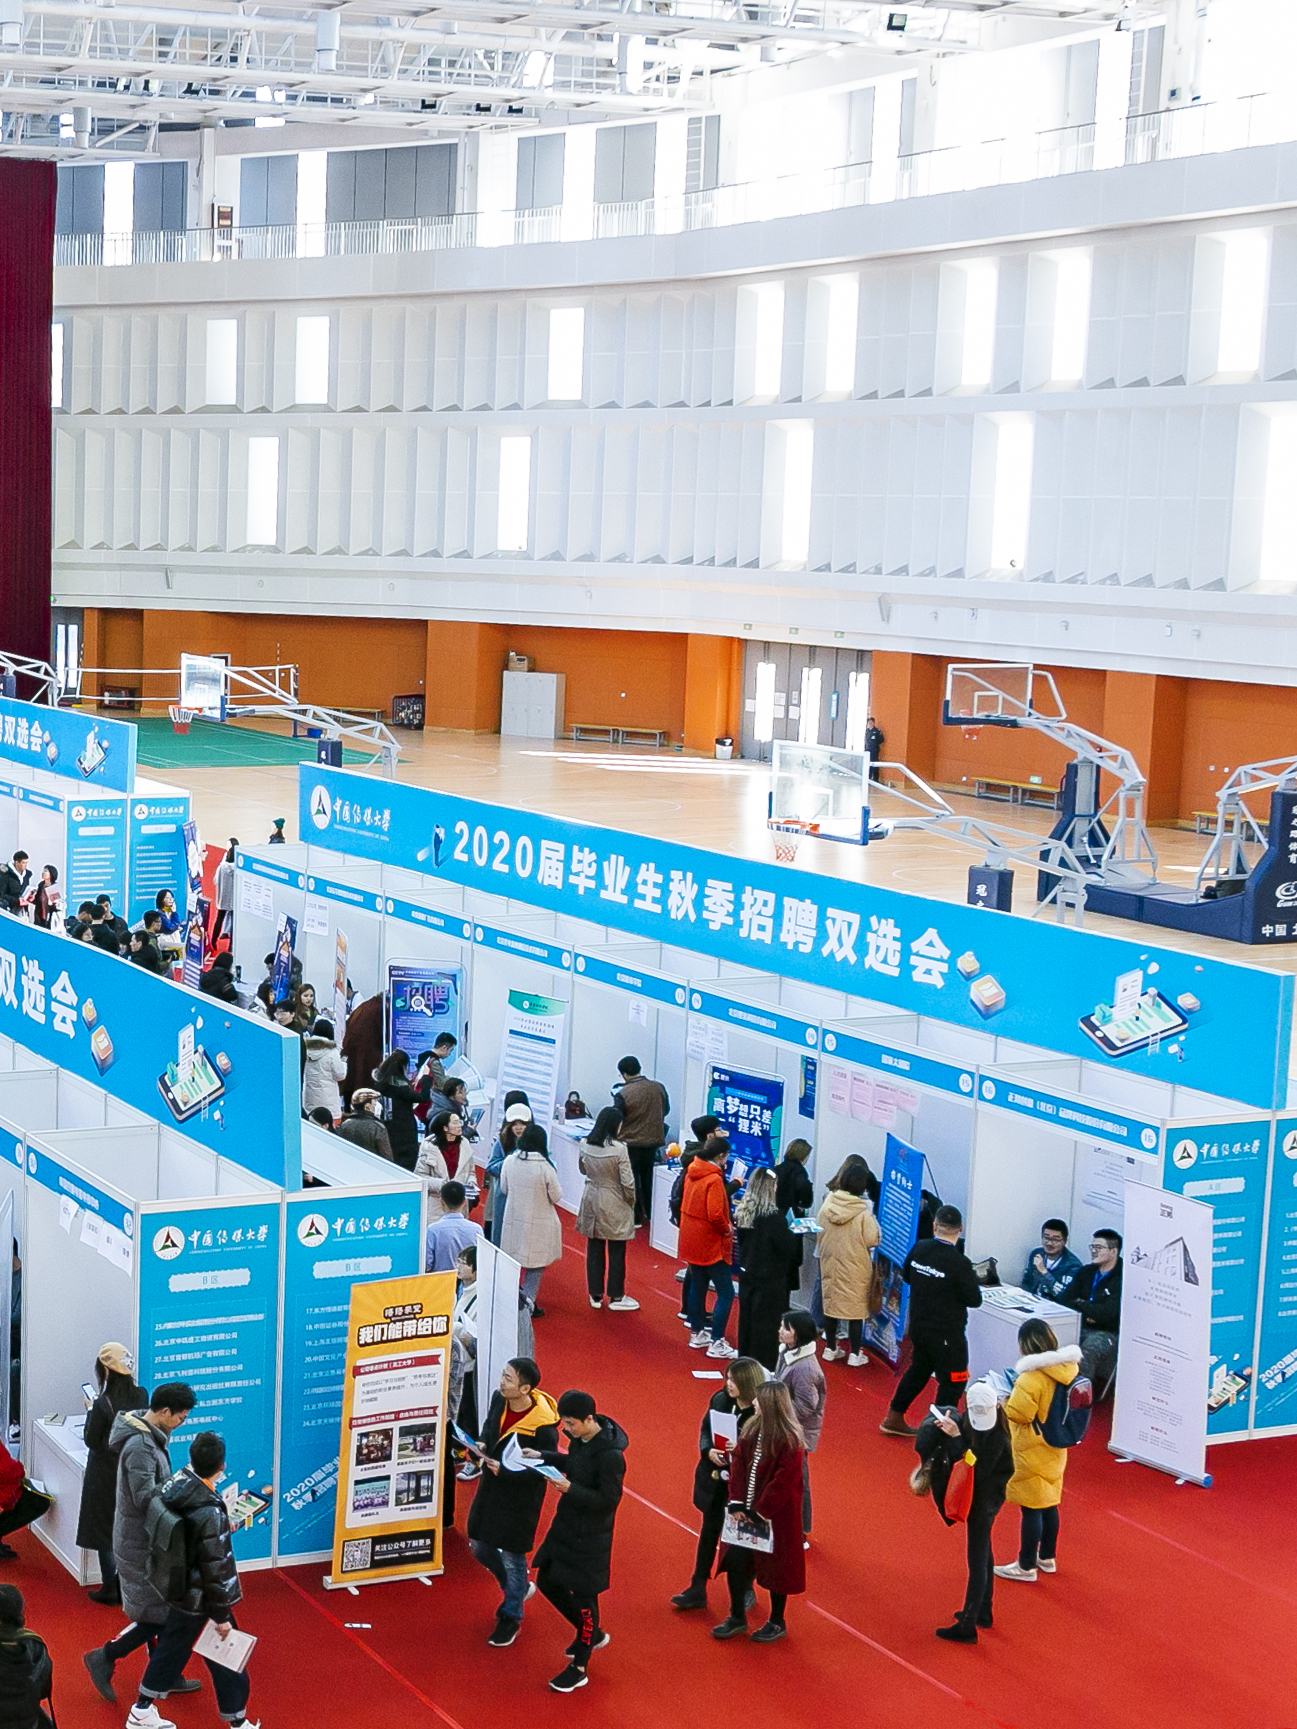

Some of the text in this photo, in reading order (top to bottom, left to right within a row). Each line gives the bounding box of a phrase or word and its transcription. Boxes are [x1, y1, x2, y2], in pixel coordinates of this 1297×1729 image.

[454, 819, 952, 989] 2020届毕业生秋季招聘双选会
[1261, 924, 1287, 937] 中国
[712, 1095, 772, 1124] 离梦想只差
[1144, 1133, 1153, 1143] 16
[331, 1213, 410, 1237] 中国传媒大学
[188, 1225, 269, 1250] 中国传媒大学
[345, 1262, 362, 1273] B区
[202, 1275, 219, 1286] B区
[359, 1315, 448, 1345] 我们能带给你
